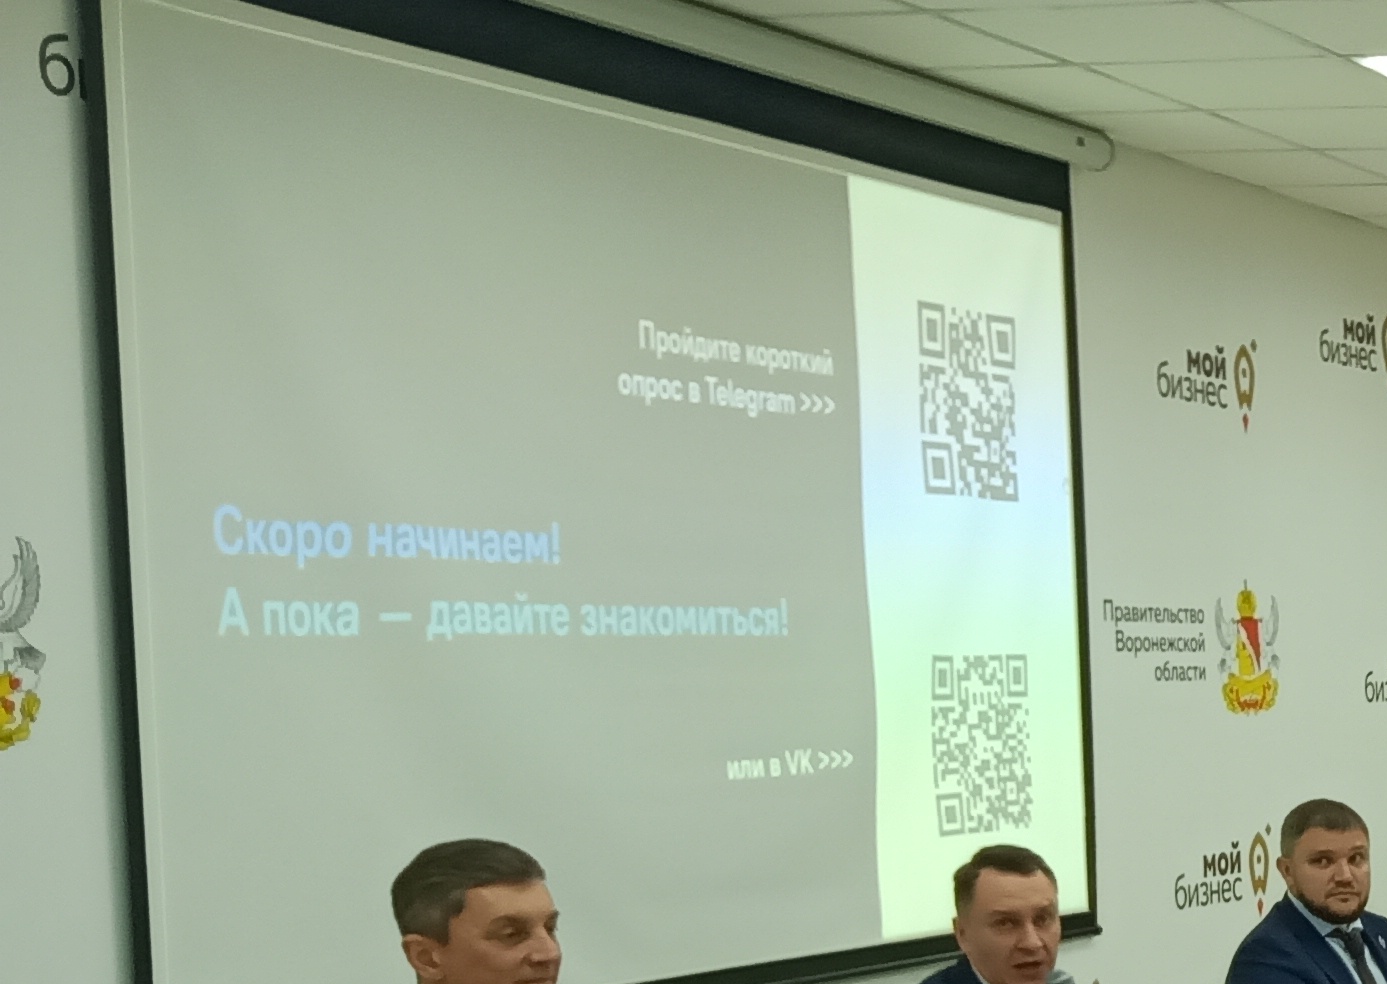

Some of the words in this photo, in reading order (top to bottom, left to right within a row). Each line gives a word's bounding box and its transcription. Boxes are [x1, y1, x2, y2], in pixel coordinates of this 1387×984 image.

[638, 319, 741, 363] Пройдите
[745, 343, 834, 376] короткий
[1343, 314, 1376, 346] мой
[1187, 345, 1226, 380] мой
[1319, 328, 1377, 373] бизнес
[618, 373, 683, 406] опрос
[688, 381, 701, 403] в
[704, 375, 796, 418] Telegram
[1157, 360, 1228, 409] бизнес
[213, 505, 352, 569] Скоро
[369, 522, 561, 565] начинаем!
[218, 587, 249, 637] А
[264, 597, 360, 637] пока
[427, 593, 570, 641] давайте
[580, 598, 789, 637] знакомиться!
[1103, 599, 1205, 626] Правительство
[1115, 629, 1206, 656] Воронежской
[1154, 660, 1206, 682] области
[727, 757, 765, 780] или
[770, 758, 781, 777] в
[784, 749, 813, 775] VK
[1203, 841, 1242, 878] мой
[1174, 873, 1243, 910] бизнес
